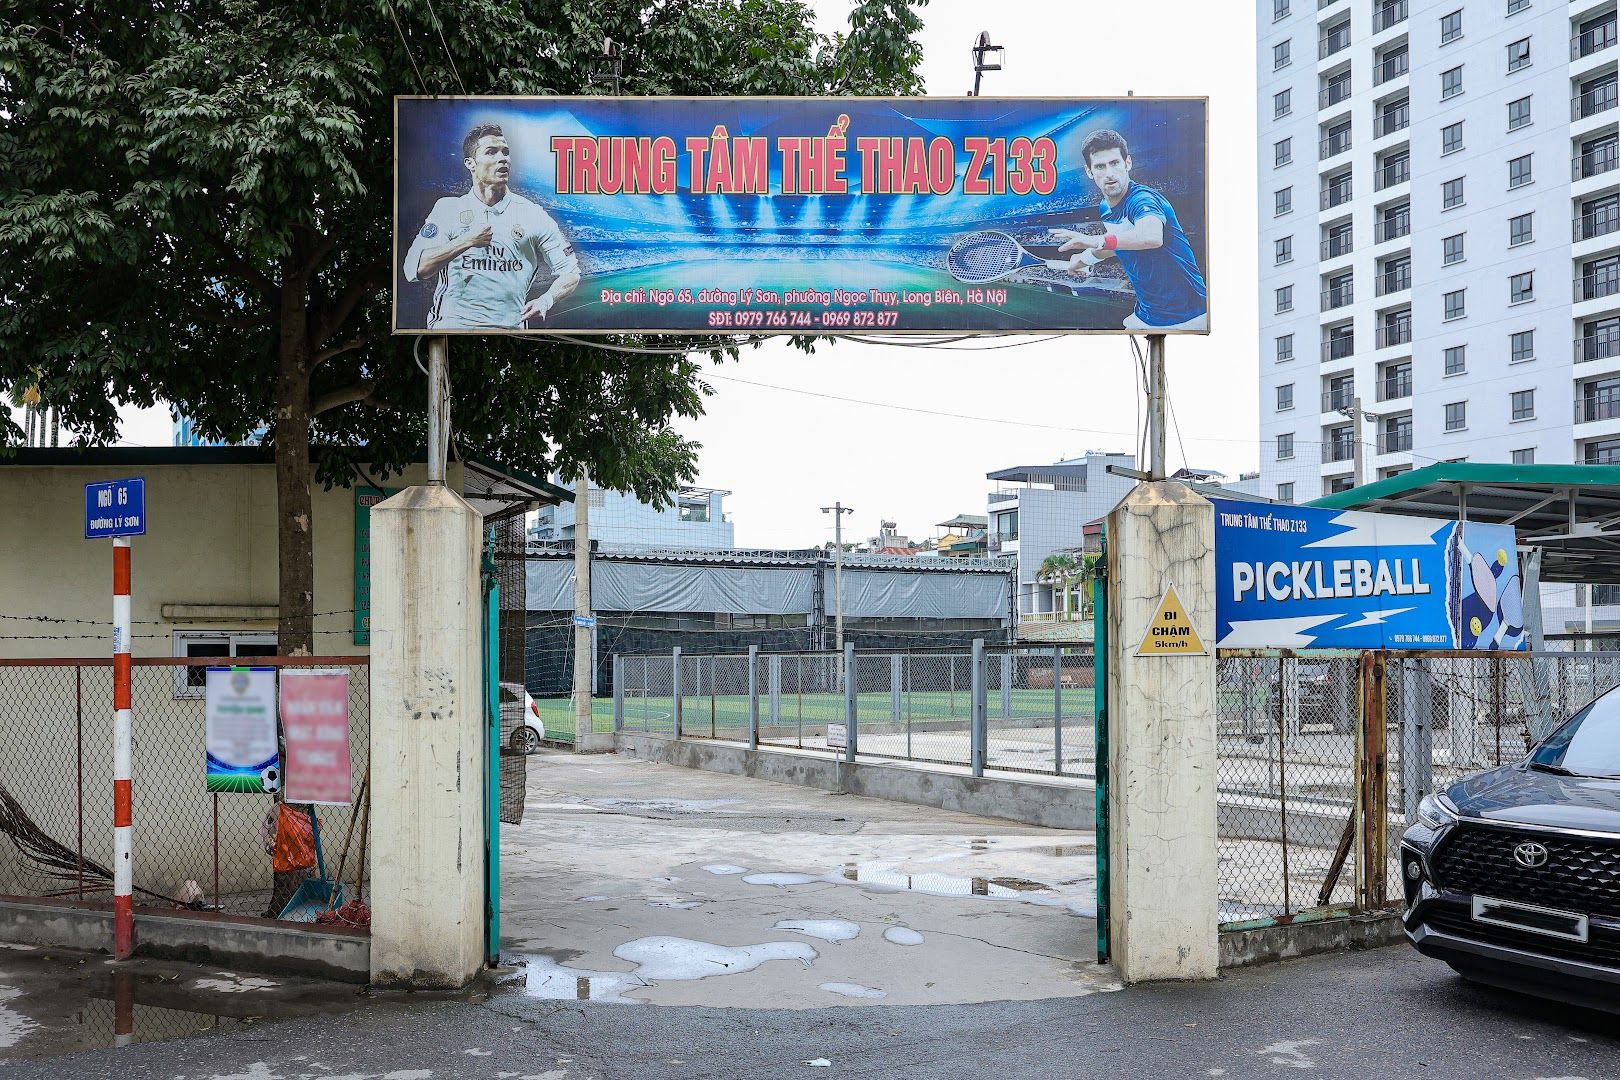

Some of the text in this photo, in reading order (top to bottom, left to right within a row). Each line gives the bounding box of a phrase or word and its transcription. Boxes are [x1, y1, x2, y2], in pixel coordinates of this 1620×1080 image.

[551, 113, 1058, 195] TRUNG TÂM THỂ THAO Z133
[461, 254, 524, 271] Emirates
[600, 287, 1007, 306] Địa chỉ: Ngõ 65, đường Lý Sơn, phường Ngọc Thụy, Long Biên, Hà Nội
[708, 311, 732, 325] SĐT:
[735, 311, 763, 326] 0979
[766, 311, 788, 326] 766
[790, 311, 812, 326] 744
[822, 311, 850, 326] 0969
[853, 311, 875, 326] 872
[877, 311, 898, 326] 877
[117, 487, 128, 506] 65
[90, 514, 140, 530] ĐƯỜNG LÝ SƠN
[1220, 512, 1307, 533] TRUNG TÂM THỂ THAO Z133
[1232, 558, 1431, 602] PICKLEBALL
[1163, 611, 1177, 621] ĐI
[1152, 625, 1190, 638] CHẬM
[1155, 640, 1188, 649] 5km/h
